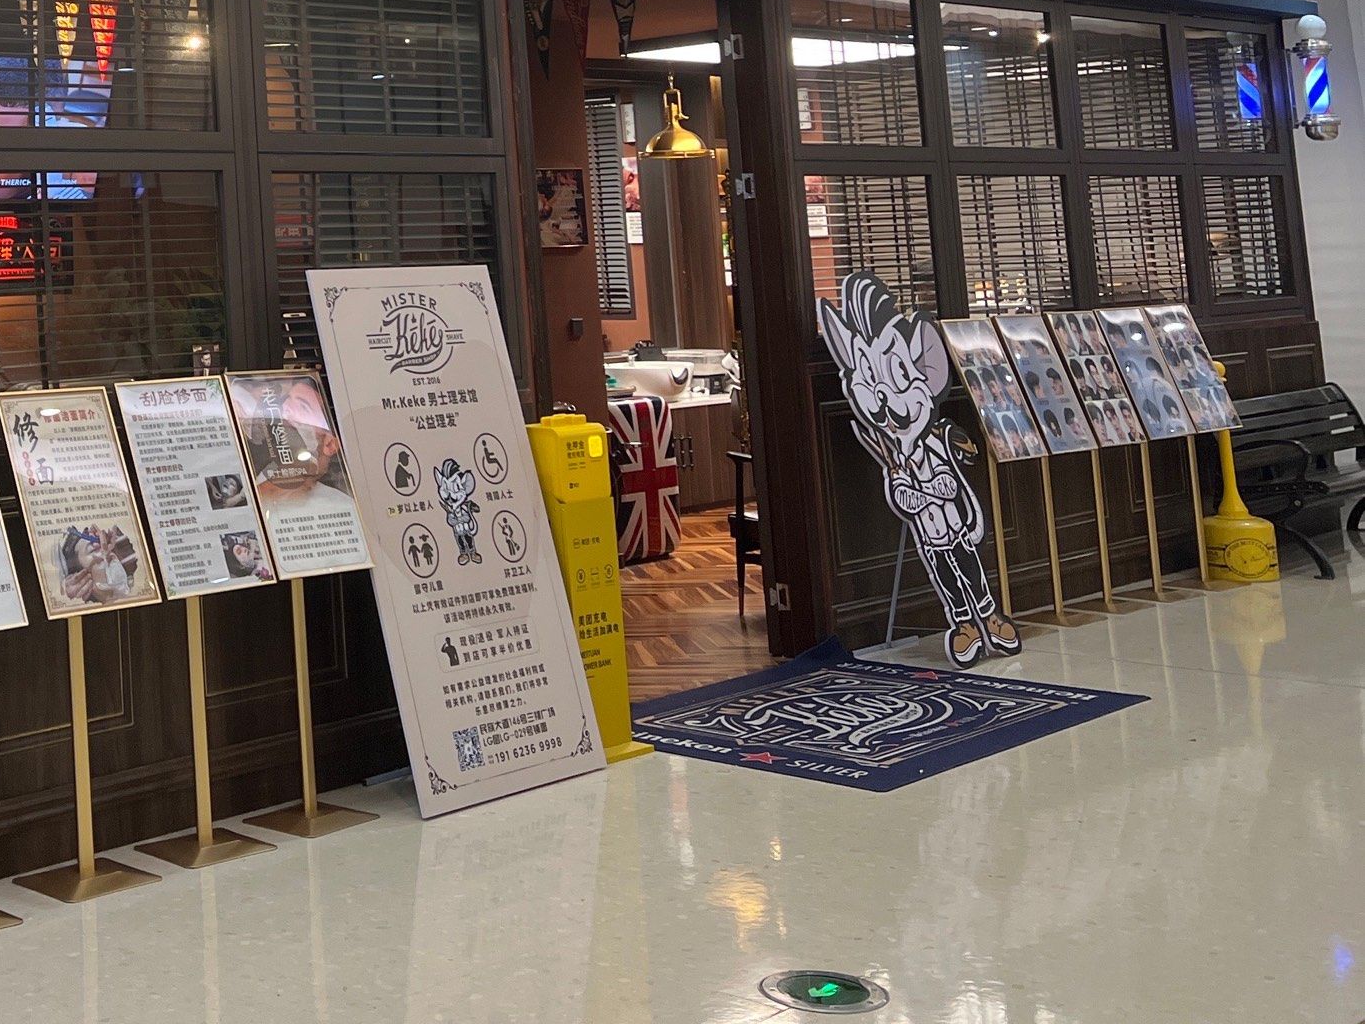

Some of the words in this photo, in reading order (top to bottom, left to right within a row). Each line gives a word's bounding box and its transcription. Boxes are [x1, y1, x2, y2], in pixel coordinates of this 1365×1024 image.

[380, 292, 437, 311] MISTER
[368, 337, 392, 345] HAIRCUT
[139, 387, 207, 407] 刮脸修面
[382, 394, 426, 410] Mr.Keke
[427, 389, 478, 407] 男士理发馆
[503, 564, 532, 578] 环卫工人
[413, 579, 444, 595] 留守儿童
[578, 612, 608, 627] 美团充电
[462, 638, 532, 663] 到店可享半价优惠
[495, 750, 510, 764] 191
[513, 743, 536, 759] 6236
[539, 736, 563, 752] 9998
[786, 758, 870, 779] SILVER
